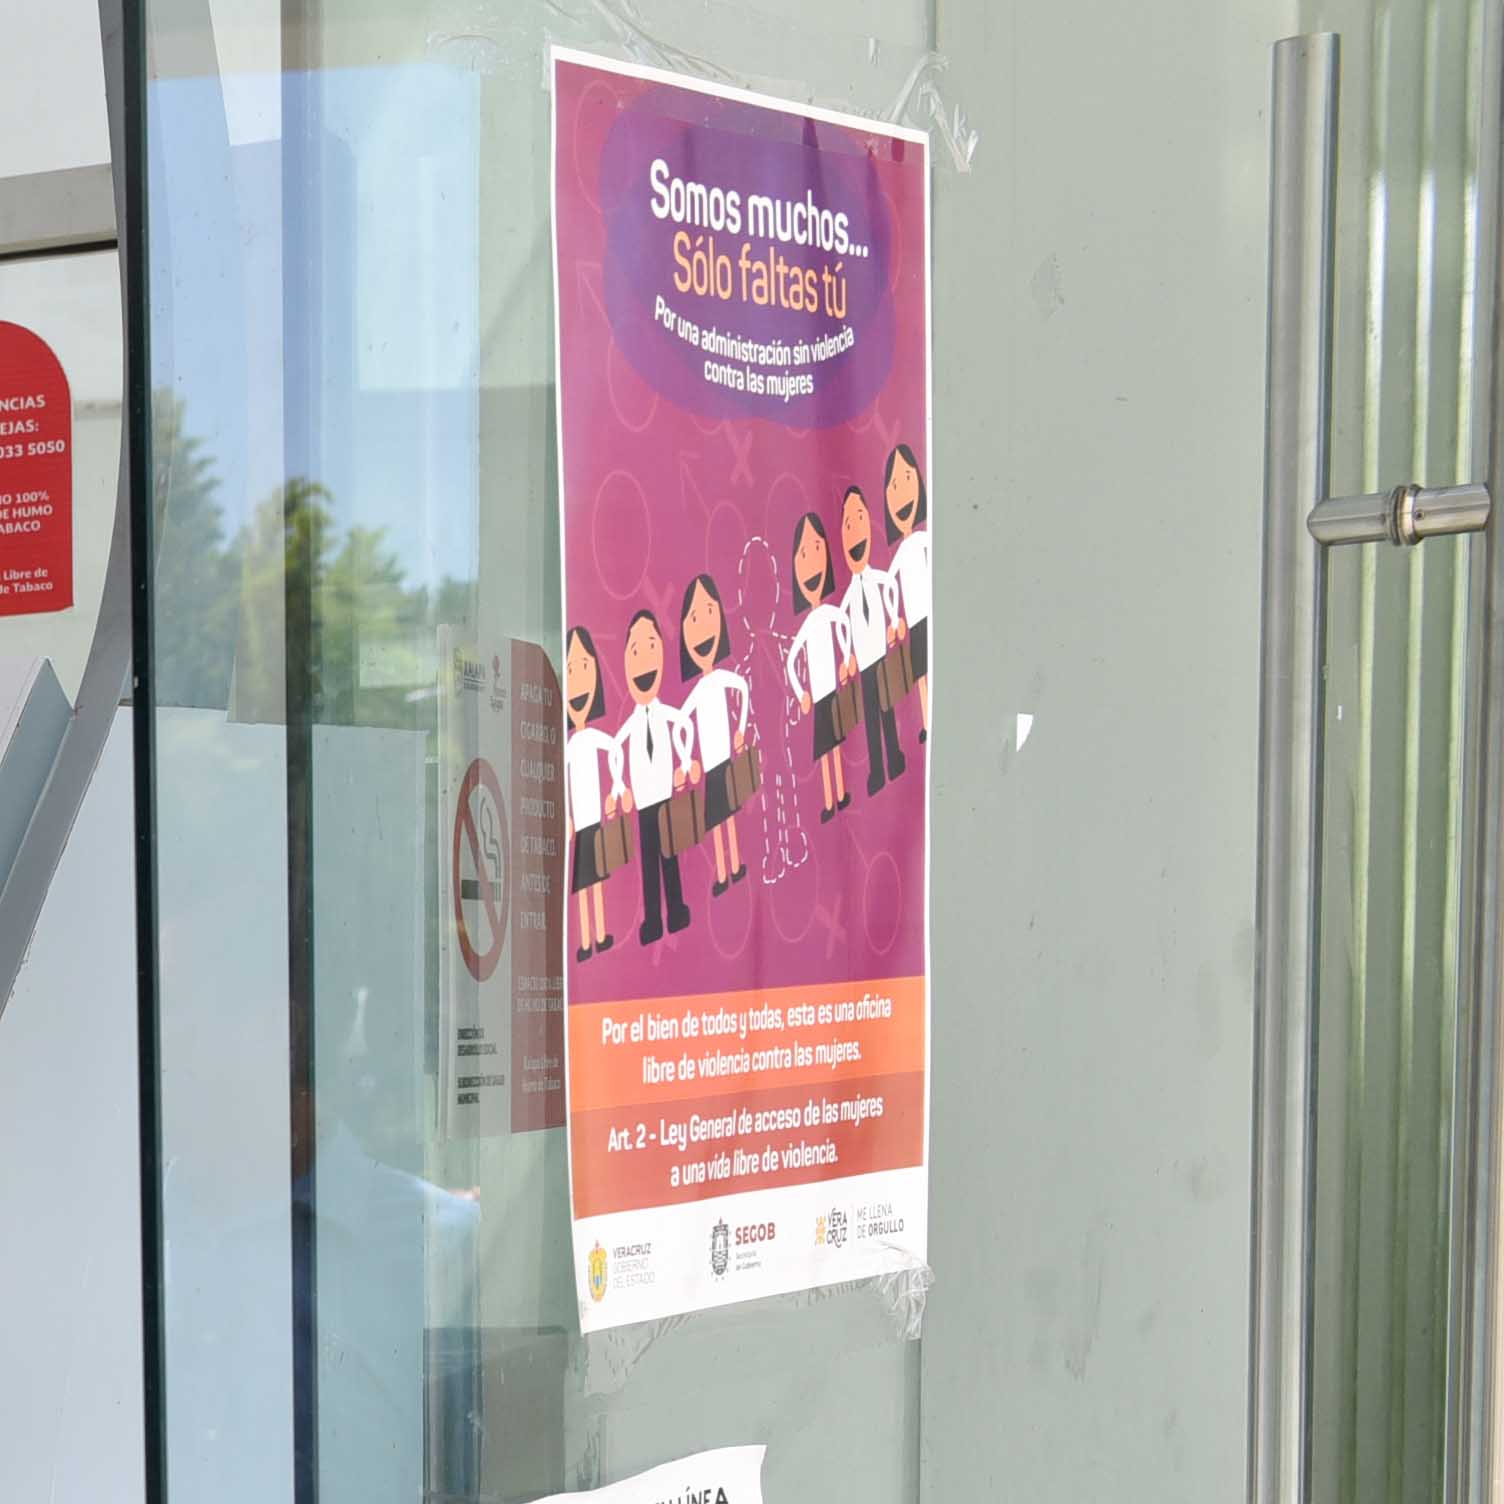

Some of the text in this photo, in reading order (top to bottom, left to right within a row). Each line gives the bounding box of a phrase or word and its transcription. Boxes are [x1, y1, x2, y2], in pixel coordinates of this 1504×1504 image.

[650, 159, 868, 257] Somos muchos...
[673, 231, 846, 319] Sólo faltas tú
[655, 295, 853, 366] Por una administración sin violencia
[705, 360, 813, 402] contra las mujeres
[27, 440, 65, 455] 5050
[15, 491, 49, 503] 100%
[12, 505, 53, 519] HUMO
[4, 569, 28, 581] Libre
[31, 567, 48, 579] de
[14, 580, 53, 593] Tabaco
[602, 993, 891, 1044] Por el bien de todos todas, esta es una oficina
[608, 1095, 883, 1152] Art. 2 Ley General de acceso de las mujeres
[735, 1222, 775, 1245] SEGOB
[868, 1219, 904, 1236] ORGULLO
[613, 1243, 651, 1258] VERACRUZ
